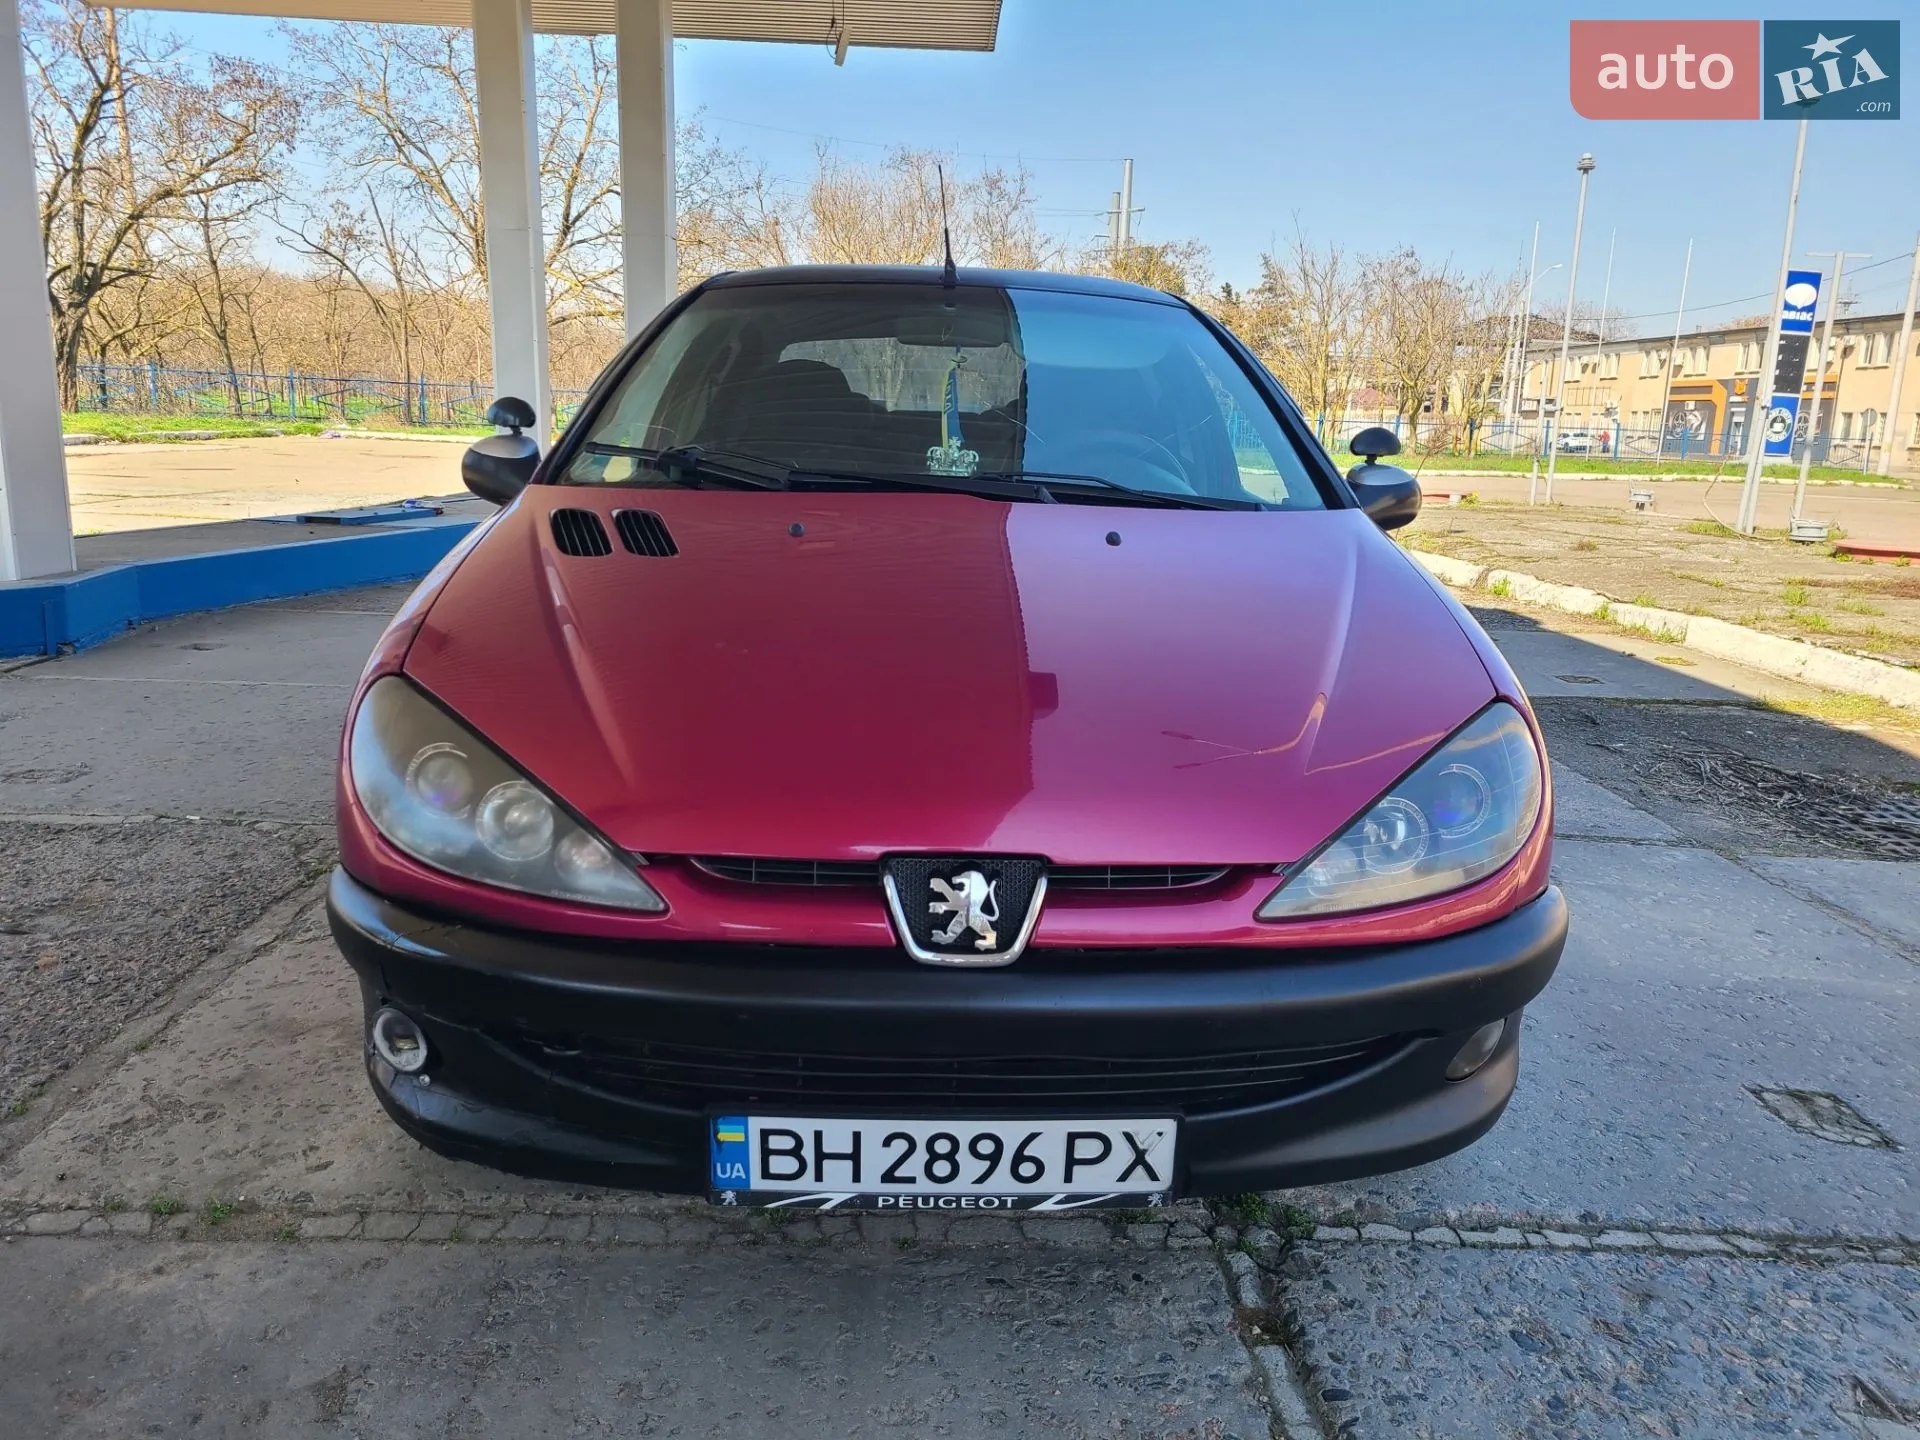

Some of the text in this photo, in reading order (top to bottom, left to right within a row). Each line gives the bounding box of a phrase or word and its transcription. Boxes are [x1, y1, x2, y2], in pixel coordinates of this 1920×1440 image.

[759, 1128, 1167, 1185] BH 2896 PX
[716, 1162, 746, 1179] UA
[877, 1196, 1019, 1209] PEUGEOT
